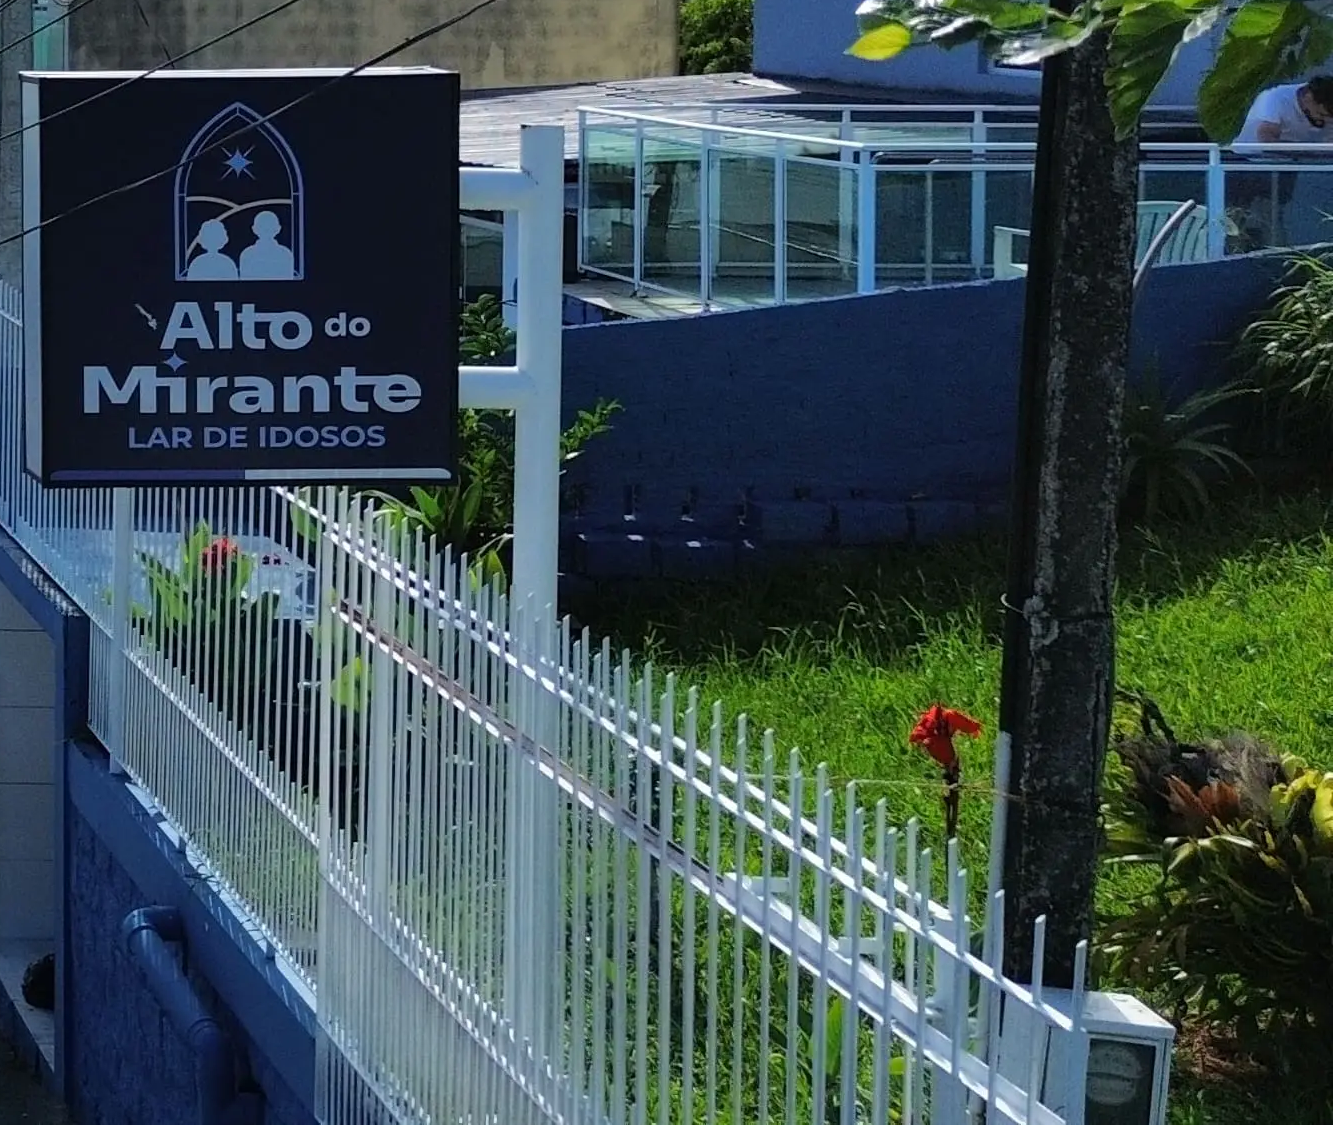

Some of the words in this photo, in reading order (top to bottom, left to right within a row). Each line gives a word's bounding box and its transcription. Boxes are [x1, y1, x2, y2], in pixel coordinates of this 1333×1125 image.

[159, 301, 313, 350] Alto
[324, 312, 371, 338] do
[83, 355, 422, 413] Mirante
[128, 426, 193, 449] LAR
[203, 426, 248, 448] DE
[259, 425, 386, 448] IDOSOS
